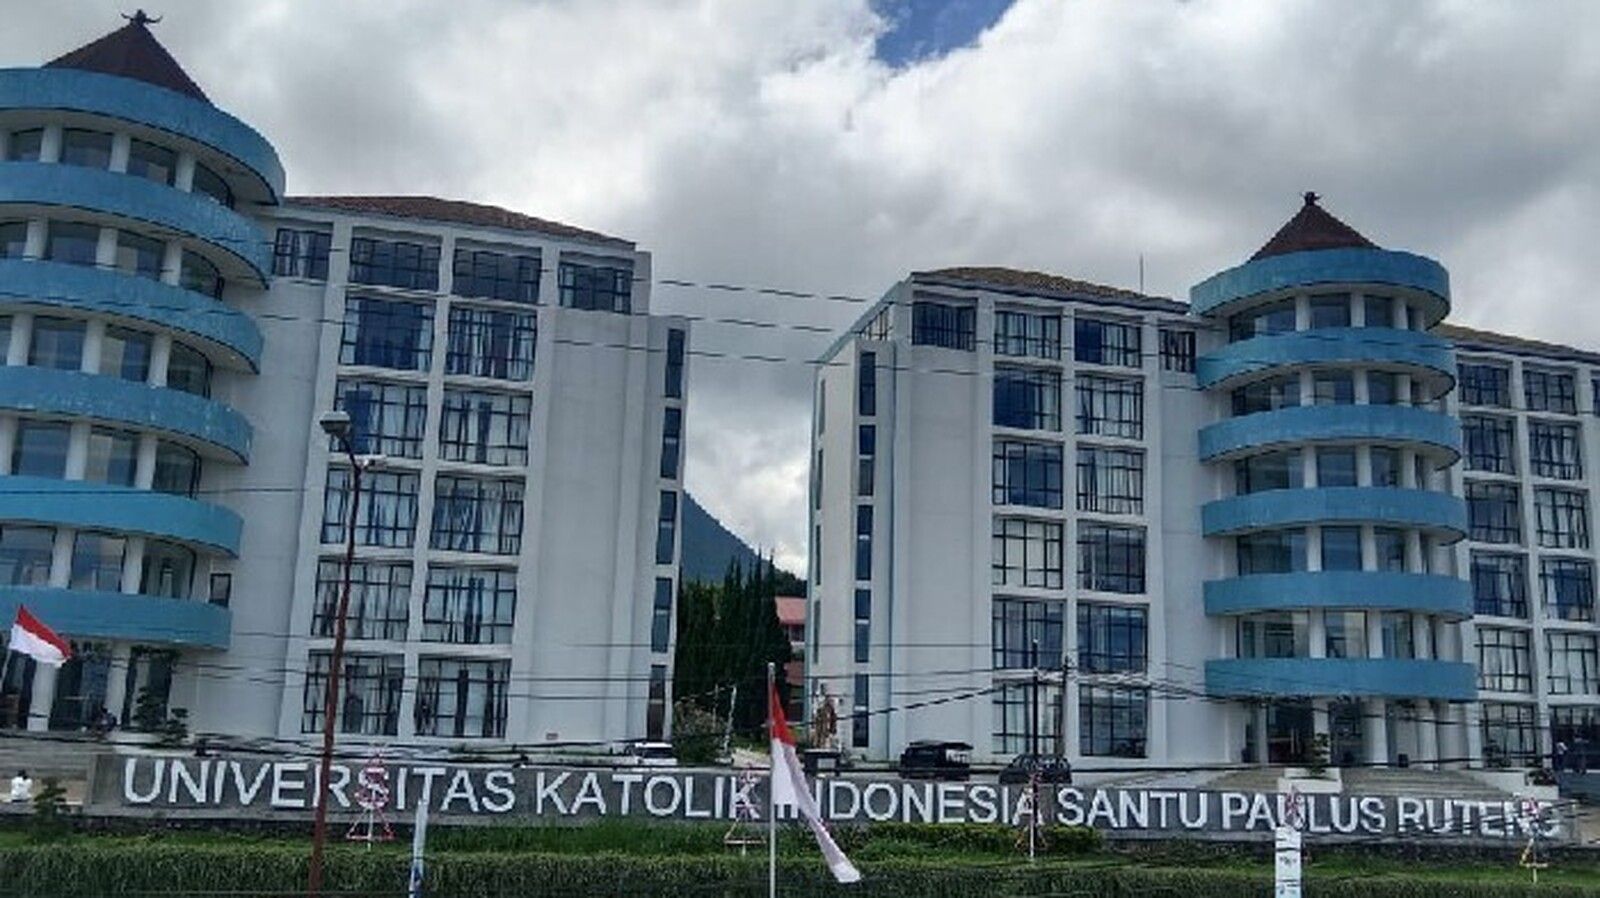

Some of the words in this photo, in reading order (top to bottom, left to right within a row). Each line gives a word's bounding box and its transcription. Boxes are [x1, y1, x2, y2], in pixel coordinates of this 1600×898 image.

[123, 758, 515, 813] UNIVERSITAS
[535, 771, 761, 819] KATOLIK
[1057, 787, 1206, 829] SANTU
[1221, 792, 1386, 834] PAULUS
